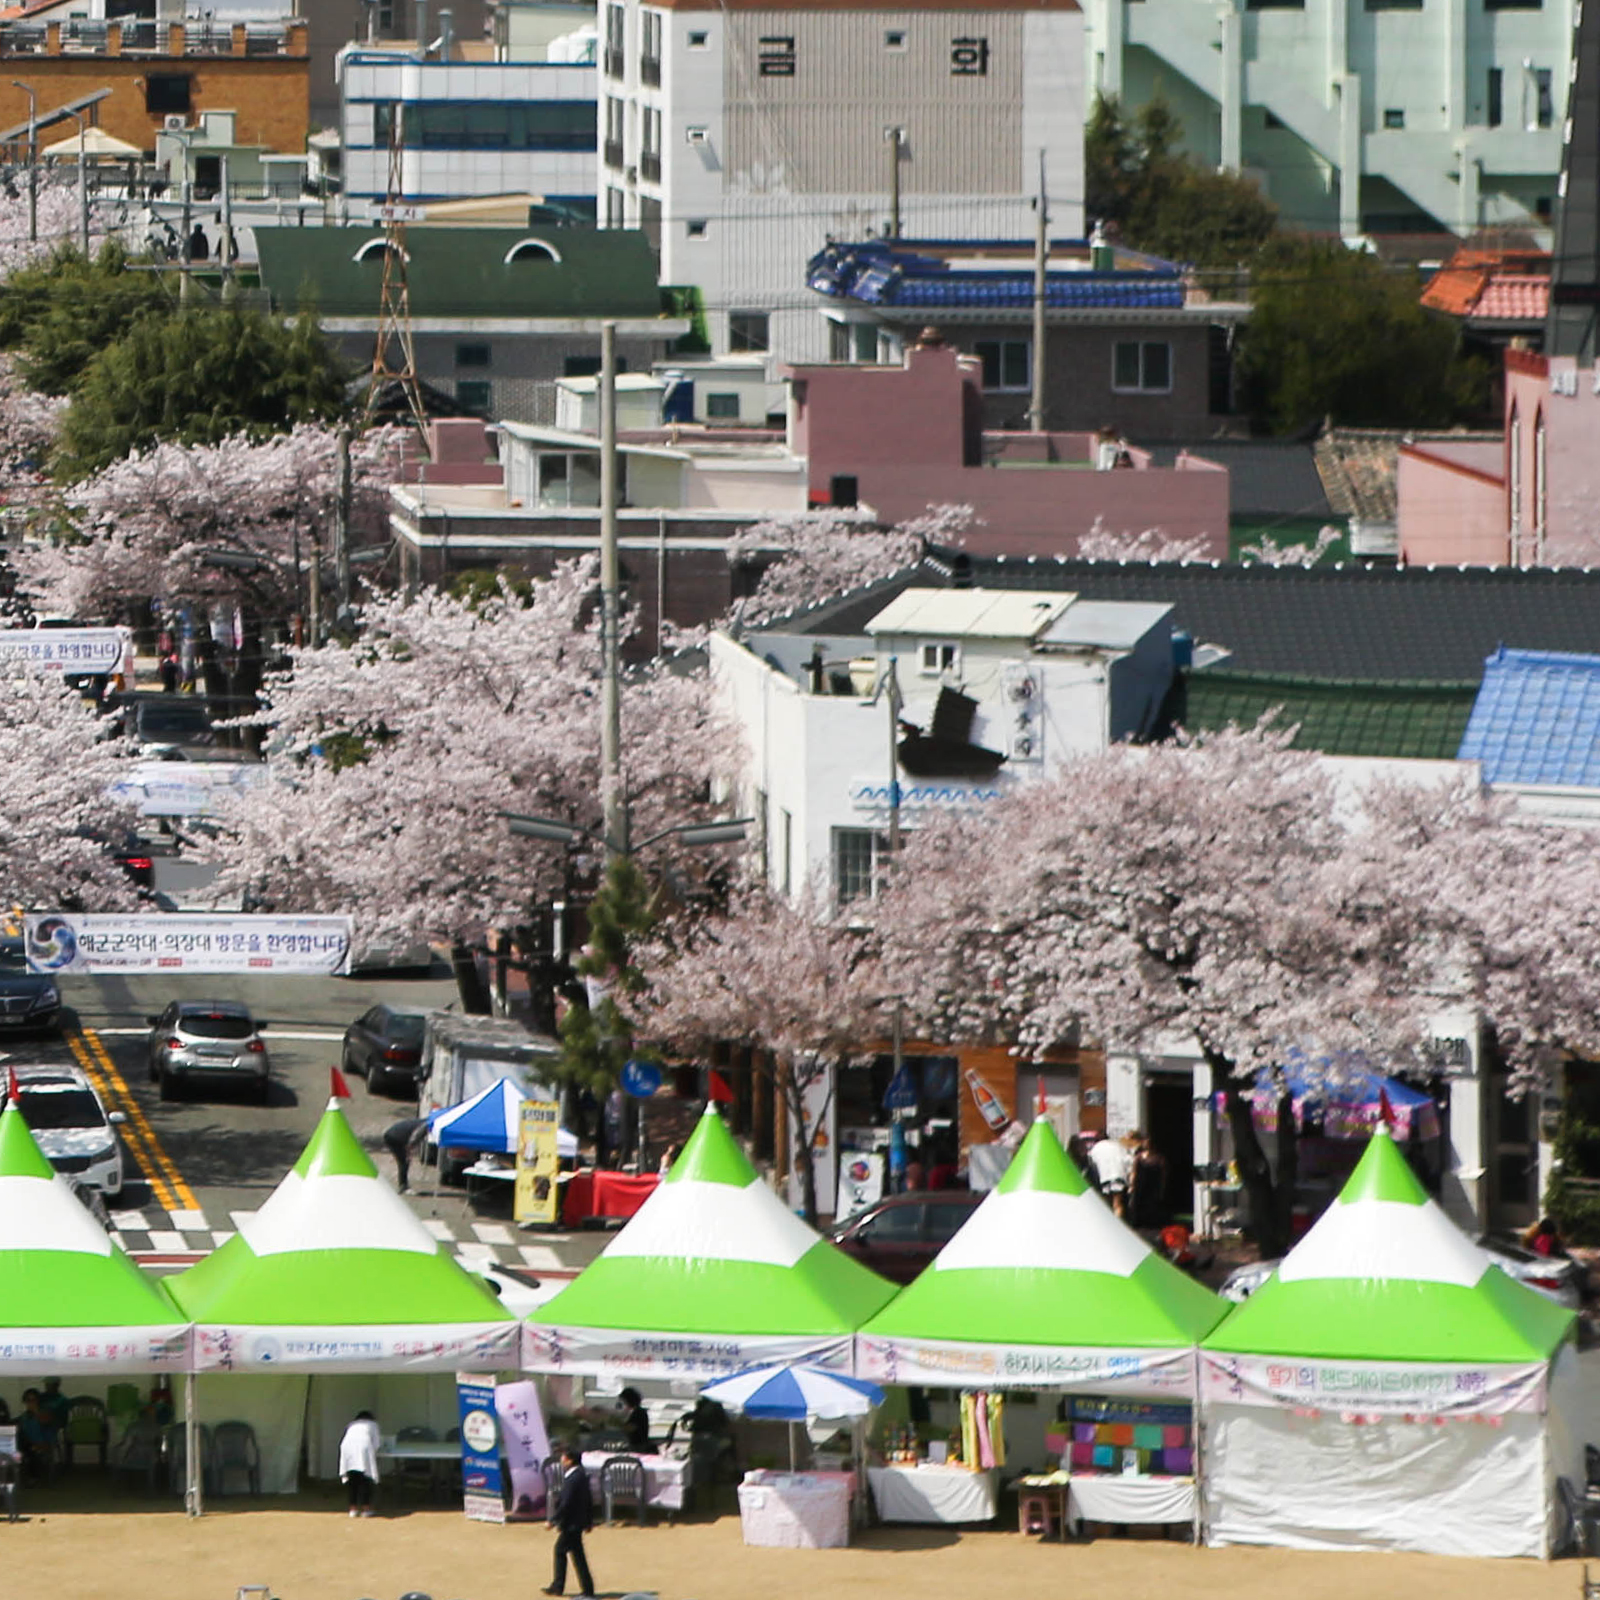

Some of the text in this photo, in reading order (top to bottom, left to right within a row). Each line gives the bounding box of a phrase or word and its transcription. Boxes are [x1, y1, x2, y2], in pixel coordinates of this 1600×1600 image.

[757, 36, 796, 77] 금
[58, 642, 117, 659] 환영합니다
[78, 932, 347, 955] 해군군악대·의장대 방문을 환영합니다
